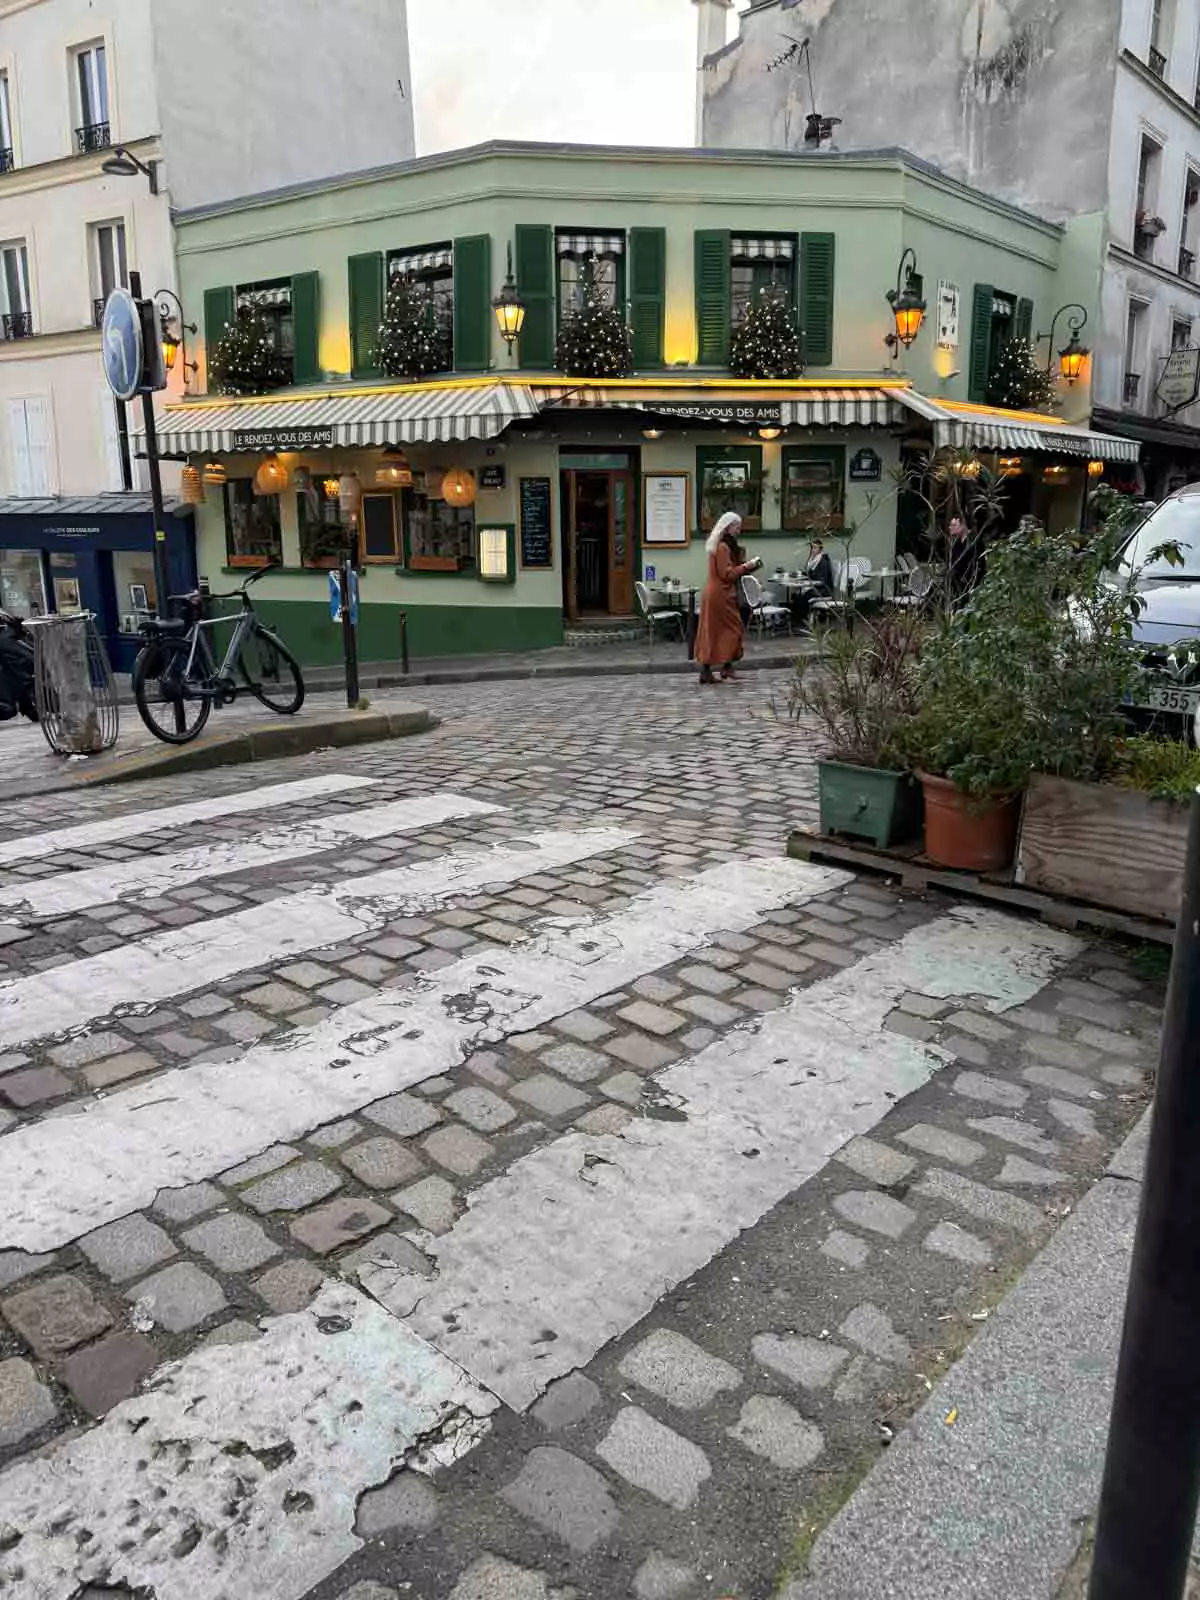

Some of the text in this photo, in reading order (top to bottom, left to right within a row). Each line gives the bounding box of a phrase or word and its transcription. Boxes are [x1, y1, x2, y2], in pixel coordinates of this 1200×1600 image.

[737, 408, 754, 417] DES
[756, 408, 780, 418] AMIS
[235, 435, 242, 445] LE
[298, 432, 312, 442] DES
[313, 431, 331, 441] AMIS
